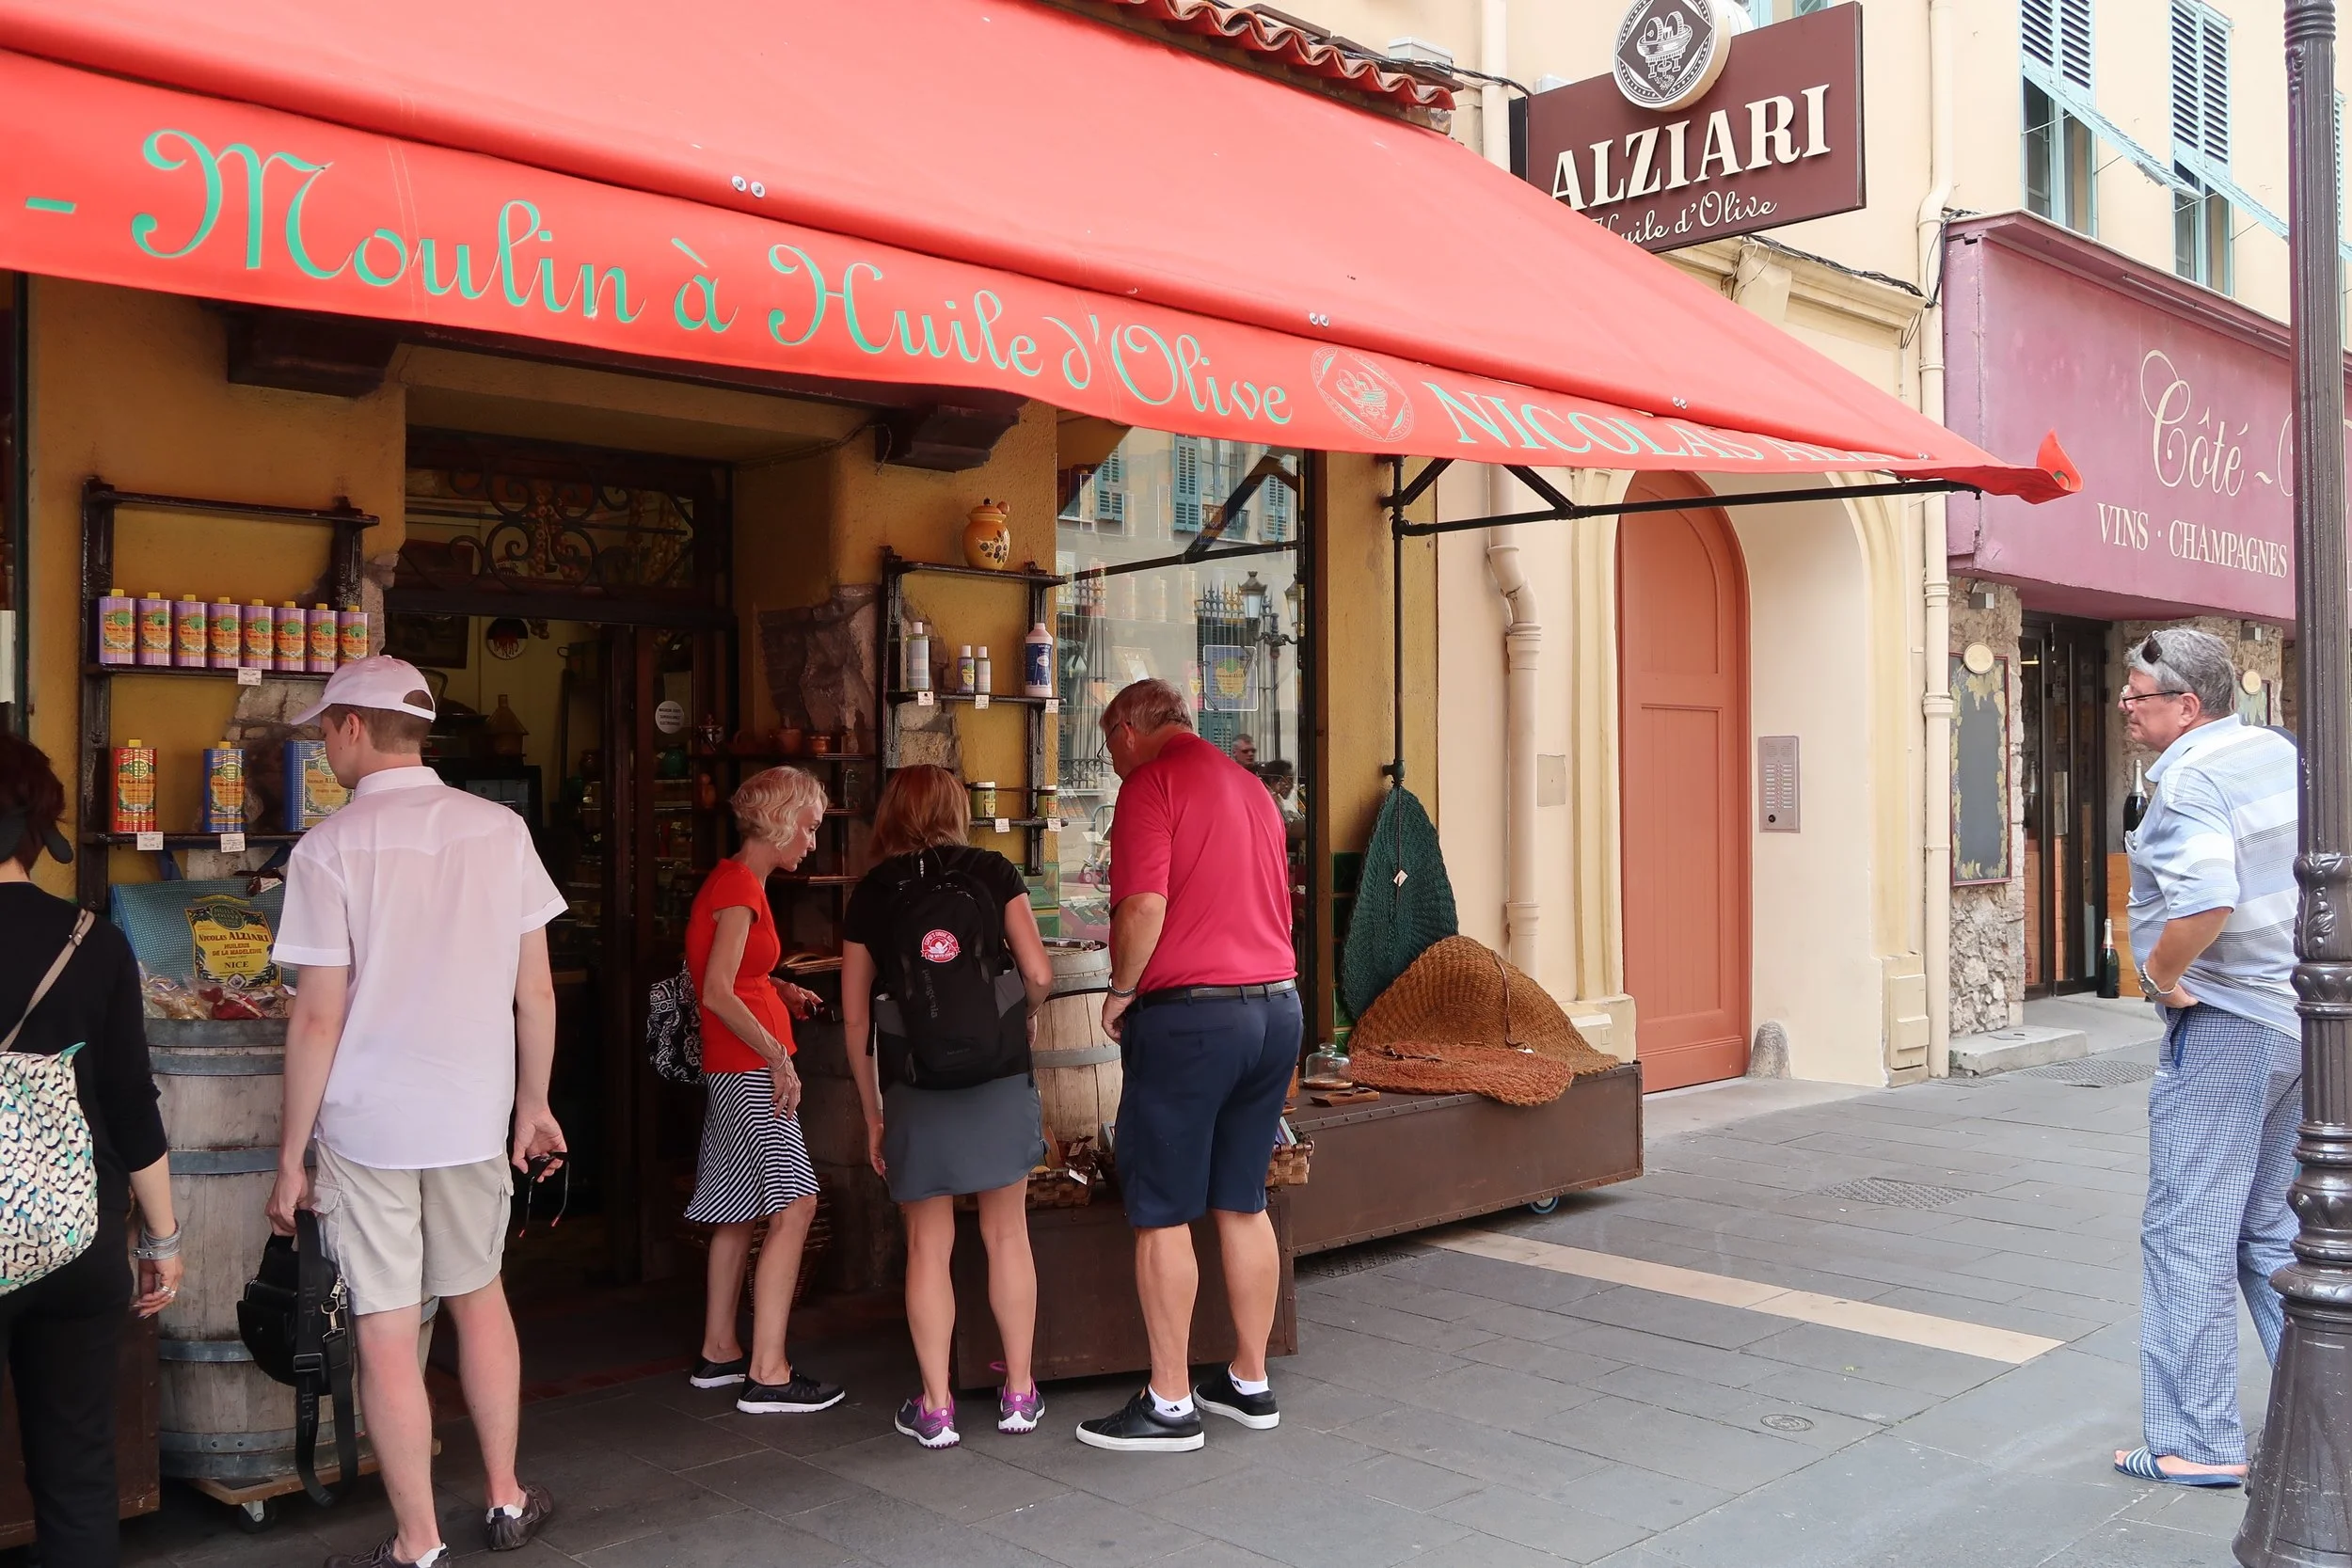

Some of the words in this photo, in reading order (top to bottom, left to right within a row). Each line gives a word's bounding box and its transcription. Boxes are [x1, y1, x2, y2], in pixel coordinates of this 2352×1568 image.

[1552, 84, 1832, 212] ALZIARI
[1674, 191, 1778, 234] d'Olive
[132, 129, 646, 323] Moulin
[672, 238, 739, 333] à
[769, 244, 1042, 376] Huile
[1043, 313, 1293, 424] d'Olive
[1422, 381, 1765, 460] NICOLAS
[2140, 349, 2249, 498] Côté
[2097, 503, 2150, 551] VINS
[2169, 520, 2288, 578] CHAMPAGNES
[229, 932, 270, 942] ALZIARI
